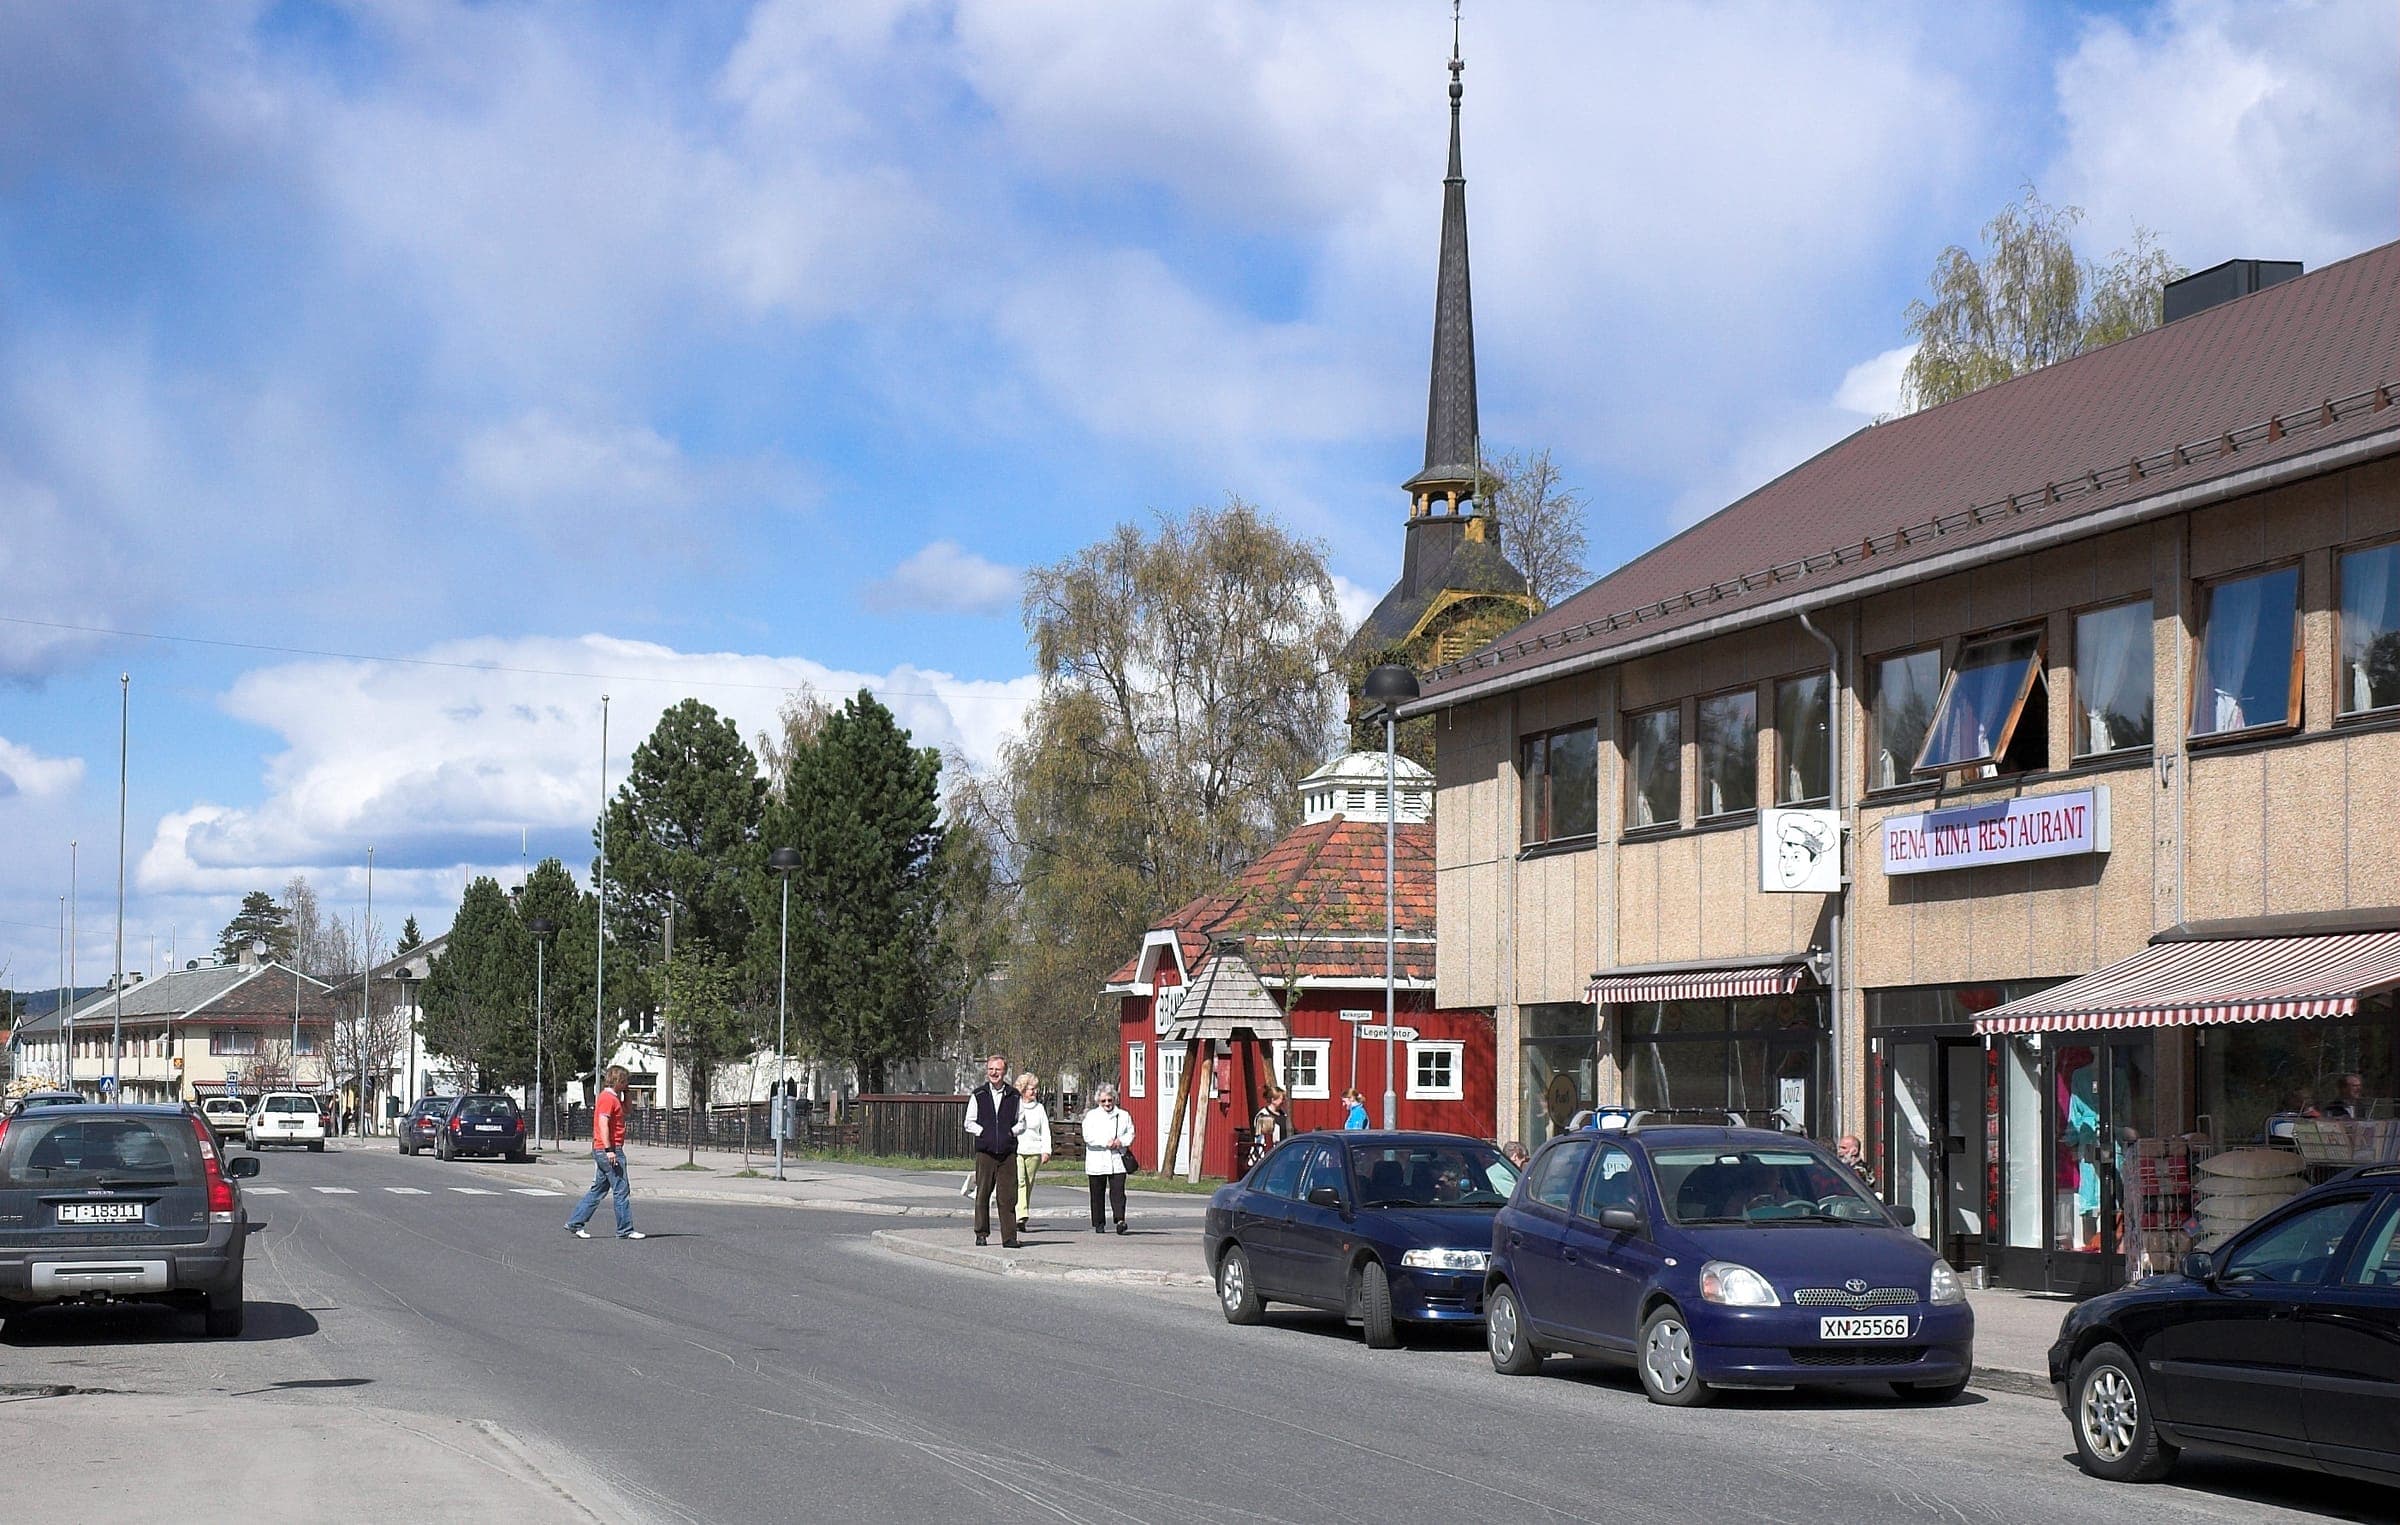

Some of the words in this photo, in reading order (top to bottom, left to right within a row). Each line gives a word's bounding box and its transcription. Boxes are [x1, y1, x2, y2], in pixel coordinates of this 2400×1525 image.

[1890, 828, 1928, 861] RENA
[1934, 821, 1971, 857] KINA
[1978, 805, 2086, 852] RESTAURANT
[1363, 1028, 1411, 1038] Legekntor
[1825, 1319, 1905, 1337] XN25566
